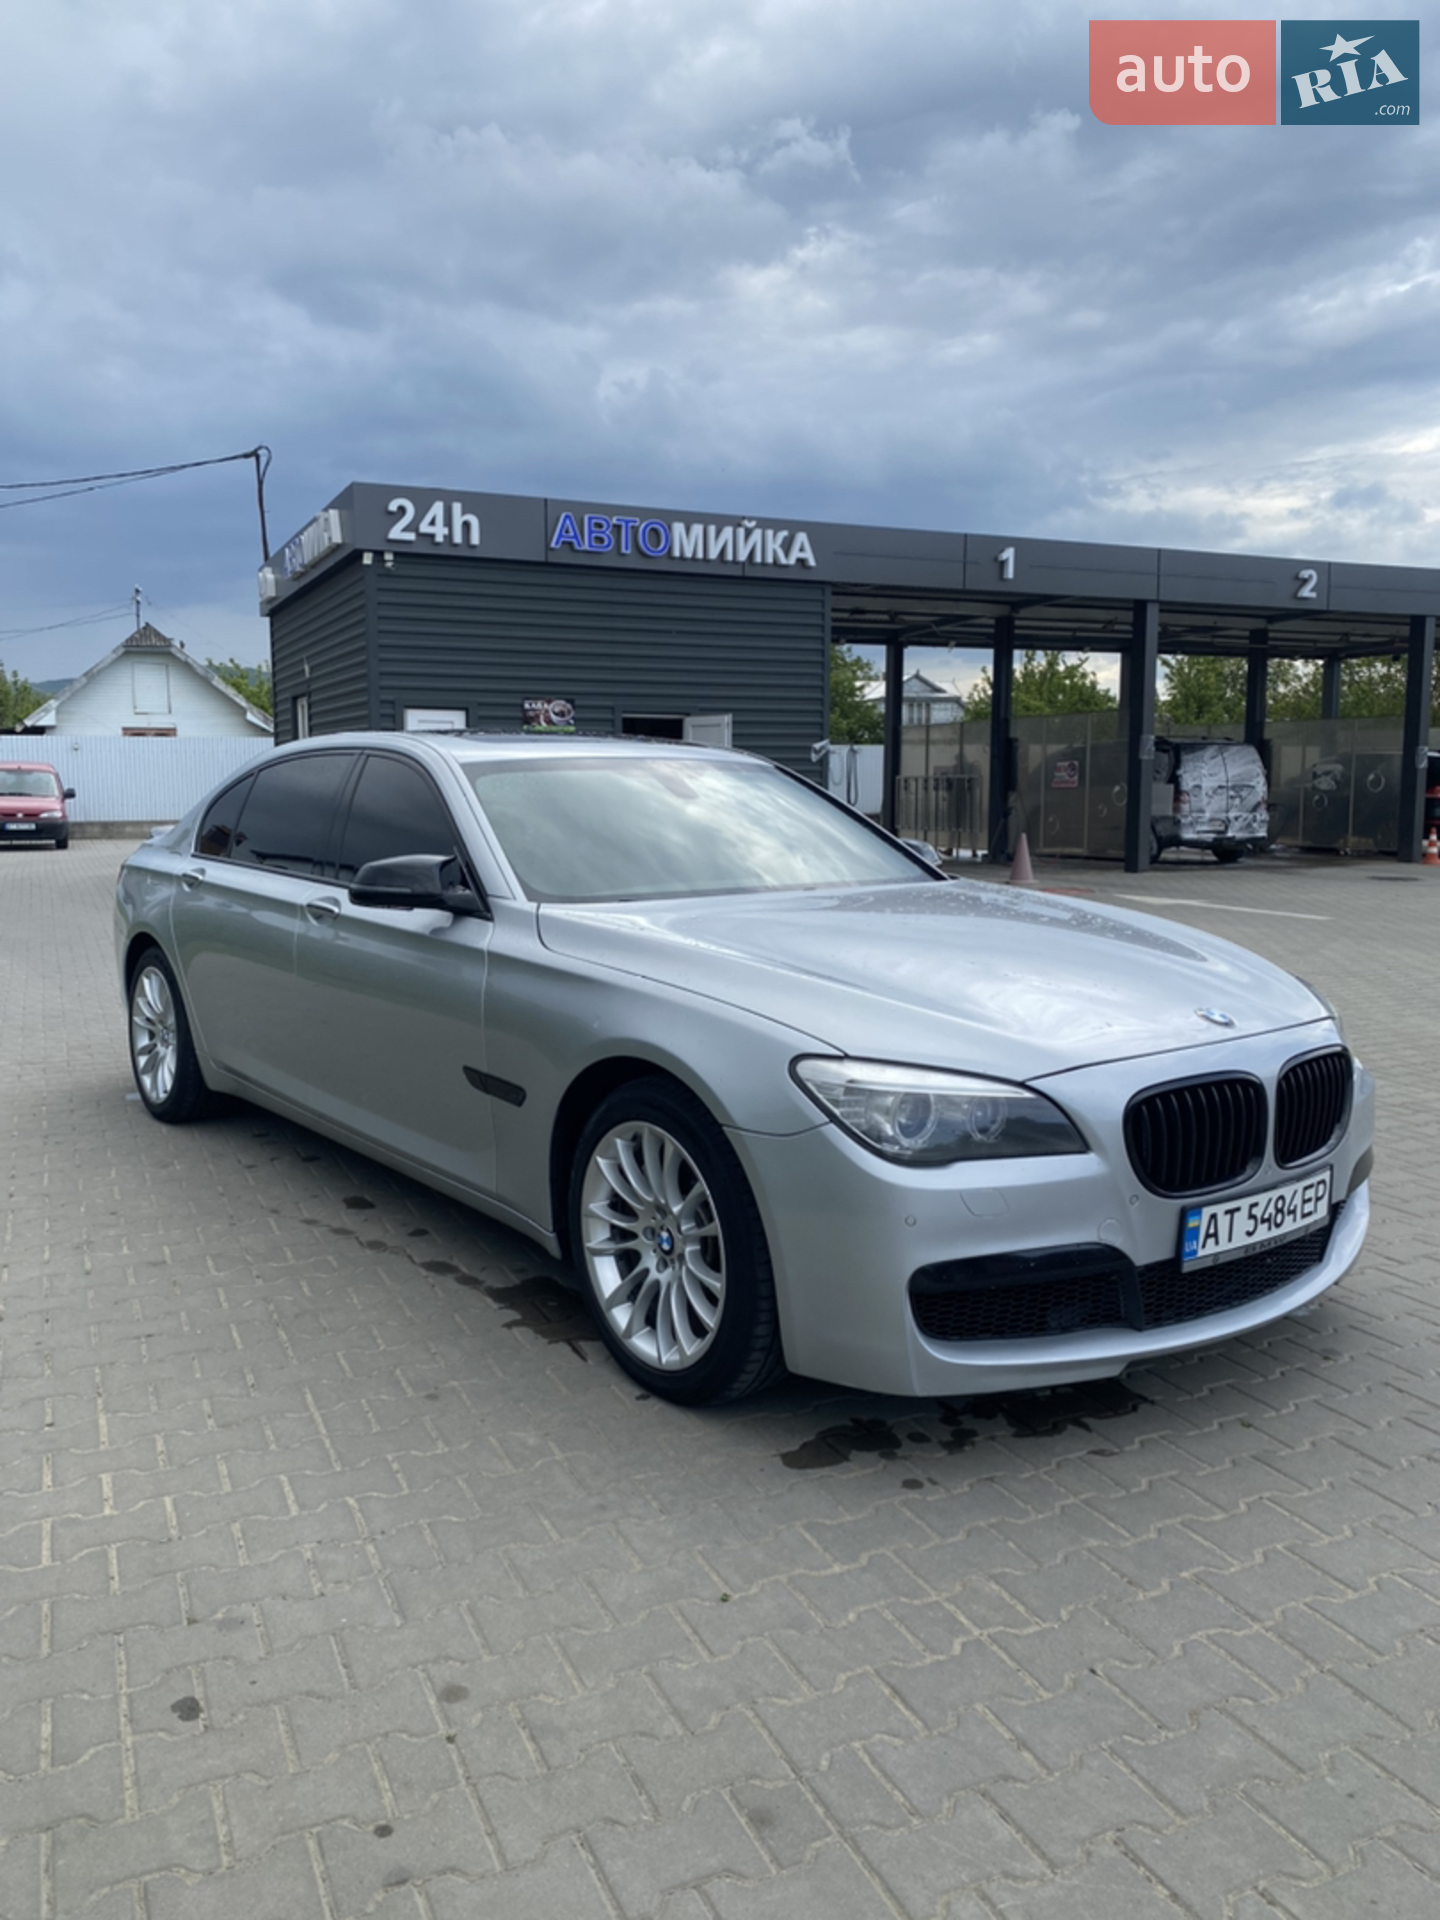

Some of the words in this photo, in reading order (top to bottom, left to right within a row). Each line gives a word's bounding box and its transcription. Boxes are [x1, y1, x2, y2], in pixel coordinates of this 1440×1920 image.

[386, 498, 481, 546] 24h
[550, 512, 817, 568] АВТОМИЙКА
[997, 546, 1016, 580] 1
[1296, 568, 1319, 599] 2
